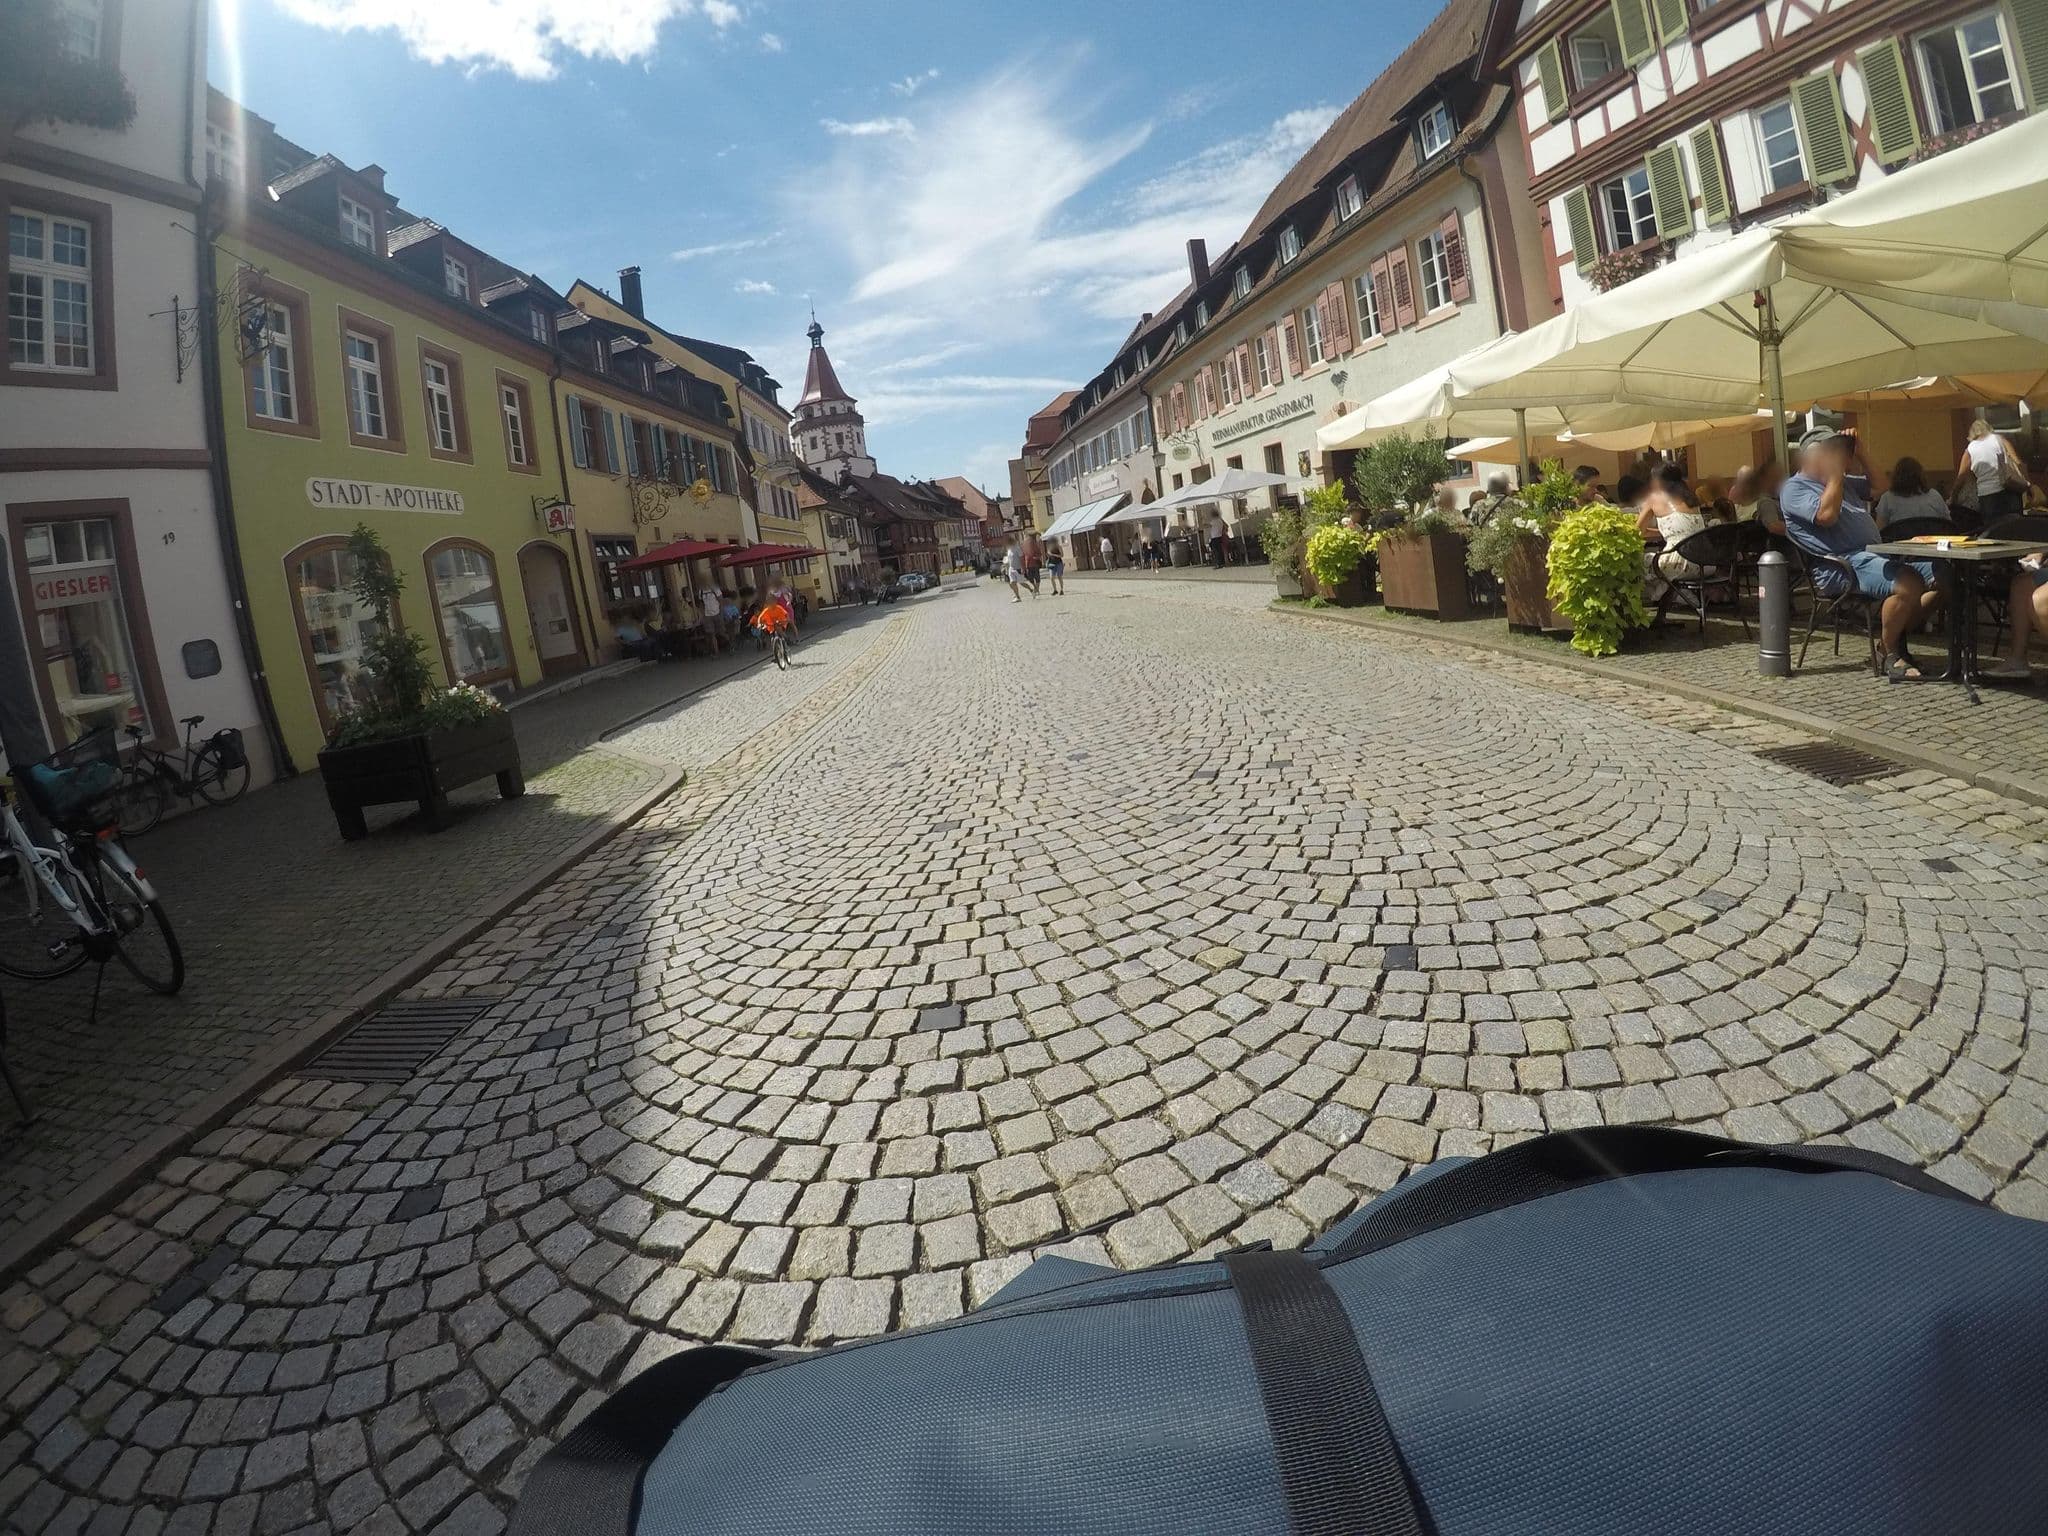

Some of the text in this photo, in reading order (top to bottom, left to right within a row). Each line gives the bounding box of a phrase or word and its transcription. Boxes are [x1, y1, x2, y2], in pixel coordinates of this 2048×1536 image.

[1211, 393, 1314, 442] WEINMANUFAKTUR GENGENBACH
[161, 531, 177, 545] 19
[35, 575, 112, 600] GIESLER
